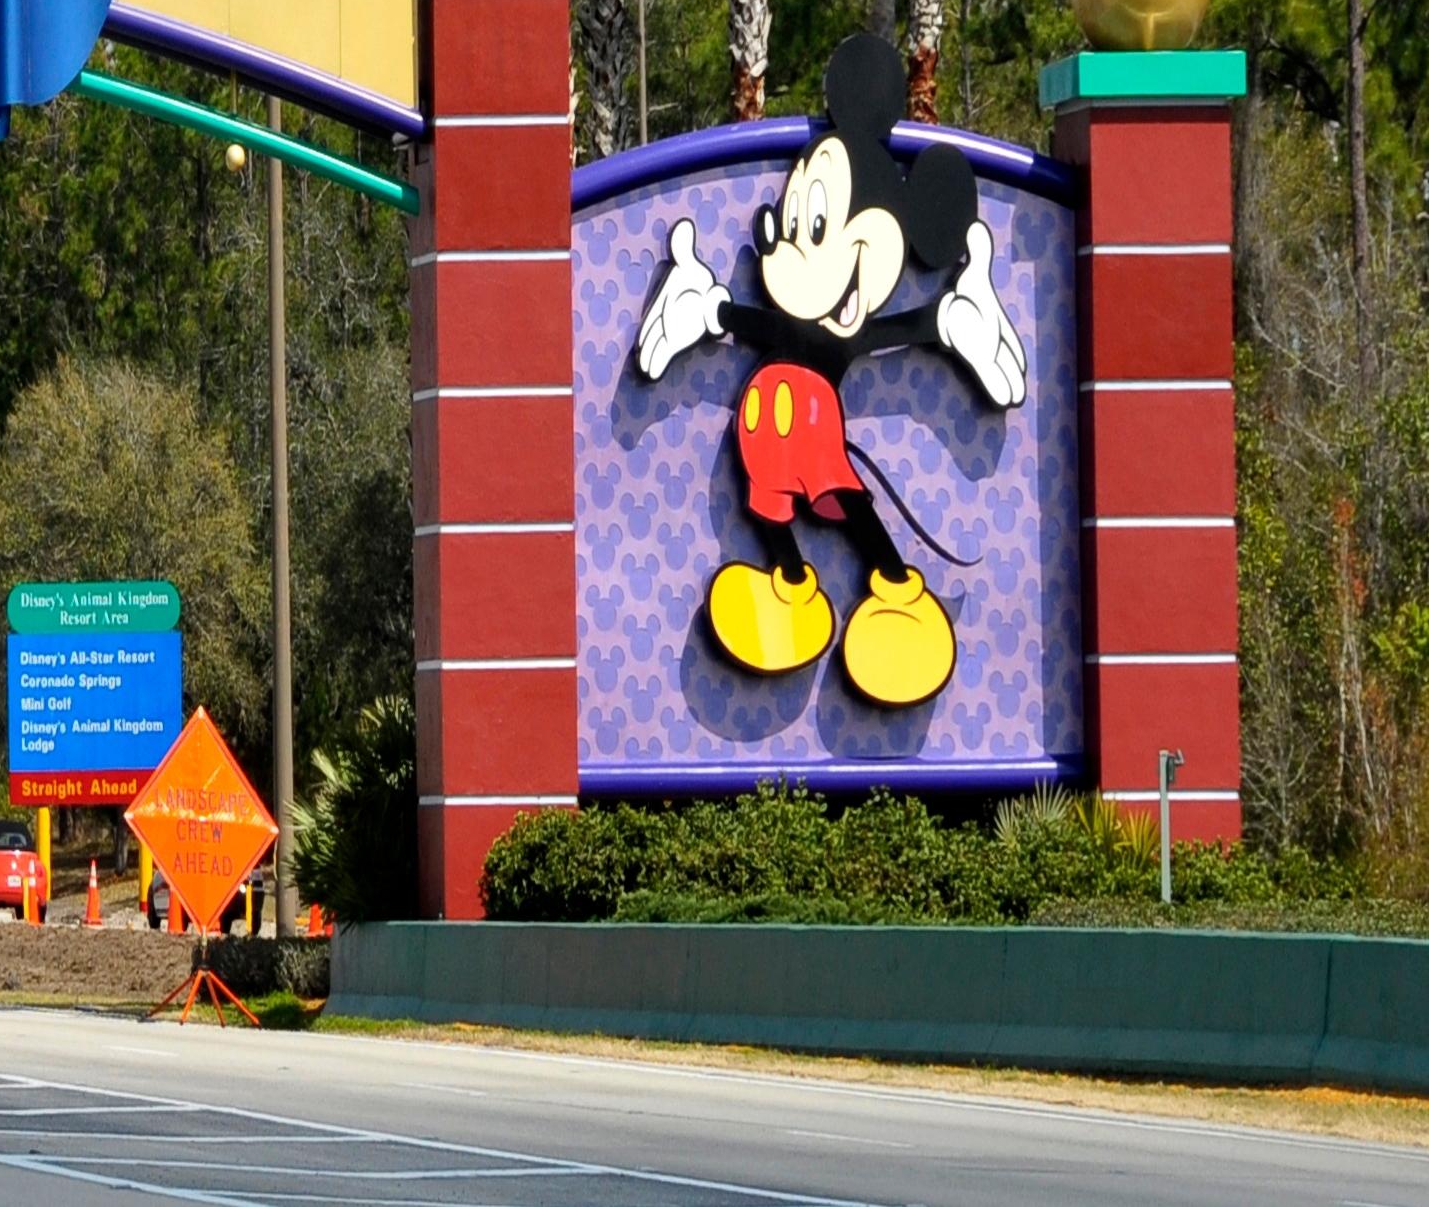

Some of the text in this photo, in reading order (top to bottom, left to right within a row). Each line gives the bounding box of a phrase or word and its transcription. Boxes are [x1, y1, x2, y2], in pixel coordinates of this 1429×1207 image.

[20, 590, 169, 610] Disney's Animal Kingdom
[59, 610, 129, 626] Resort Area
[19, 649, 155, 667] Disney's All-Star Resort
[20, 673, 122, 691] Coronado Springs
[20, 696, 72, 711] Mini Golf
[21, 718, 164, 736] Disney's Animal Kingdom
[21, 737, 55, 754] Lodge
[21, 778, 138, 800] Straight Ahead
[155, 787, 248, 815] LANDSCAPE
[176, 819, 223, 844] CREW
[173, 851, 234, 877] AHEAD
